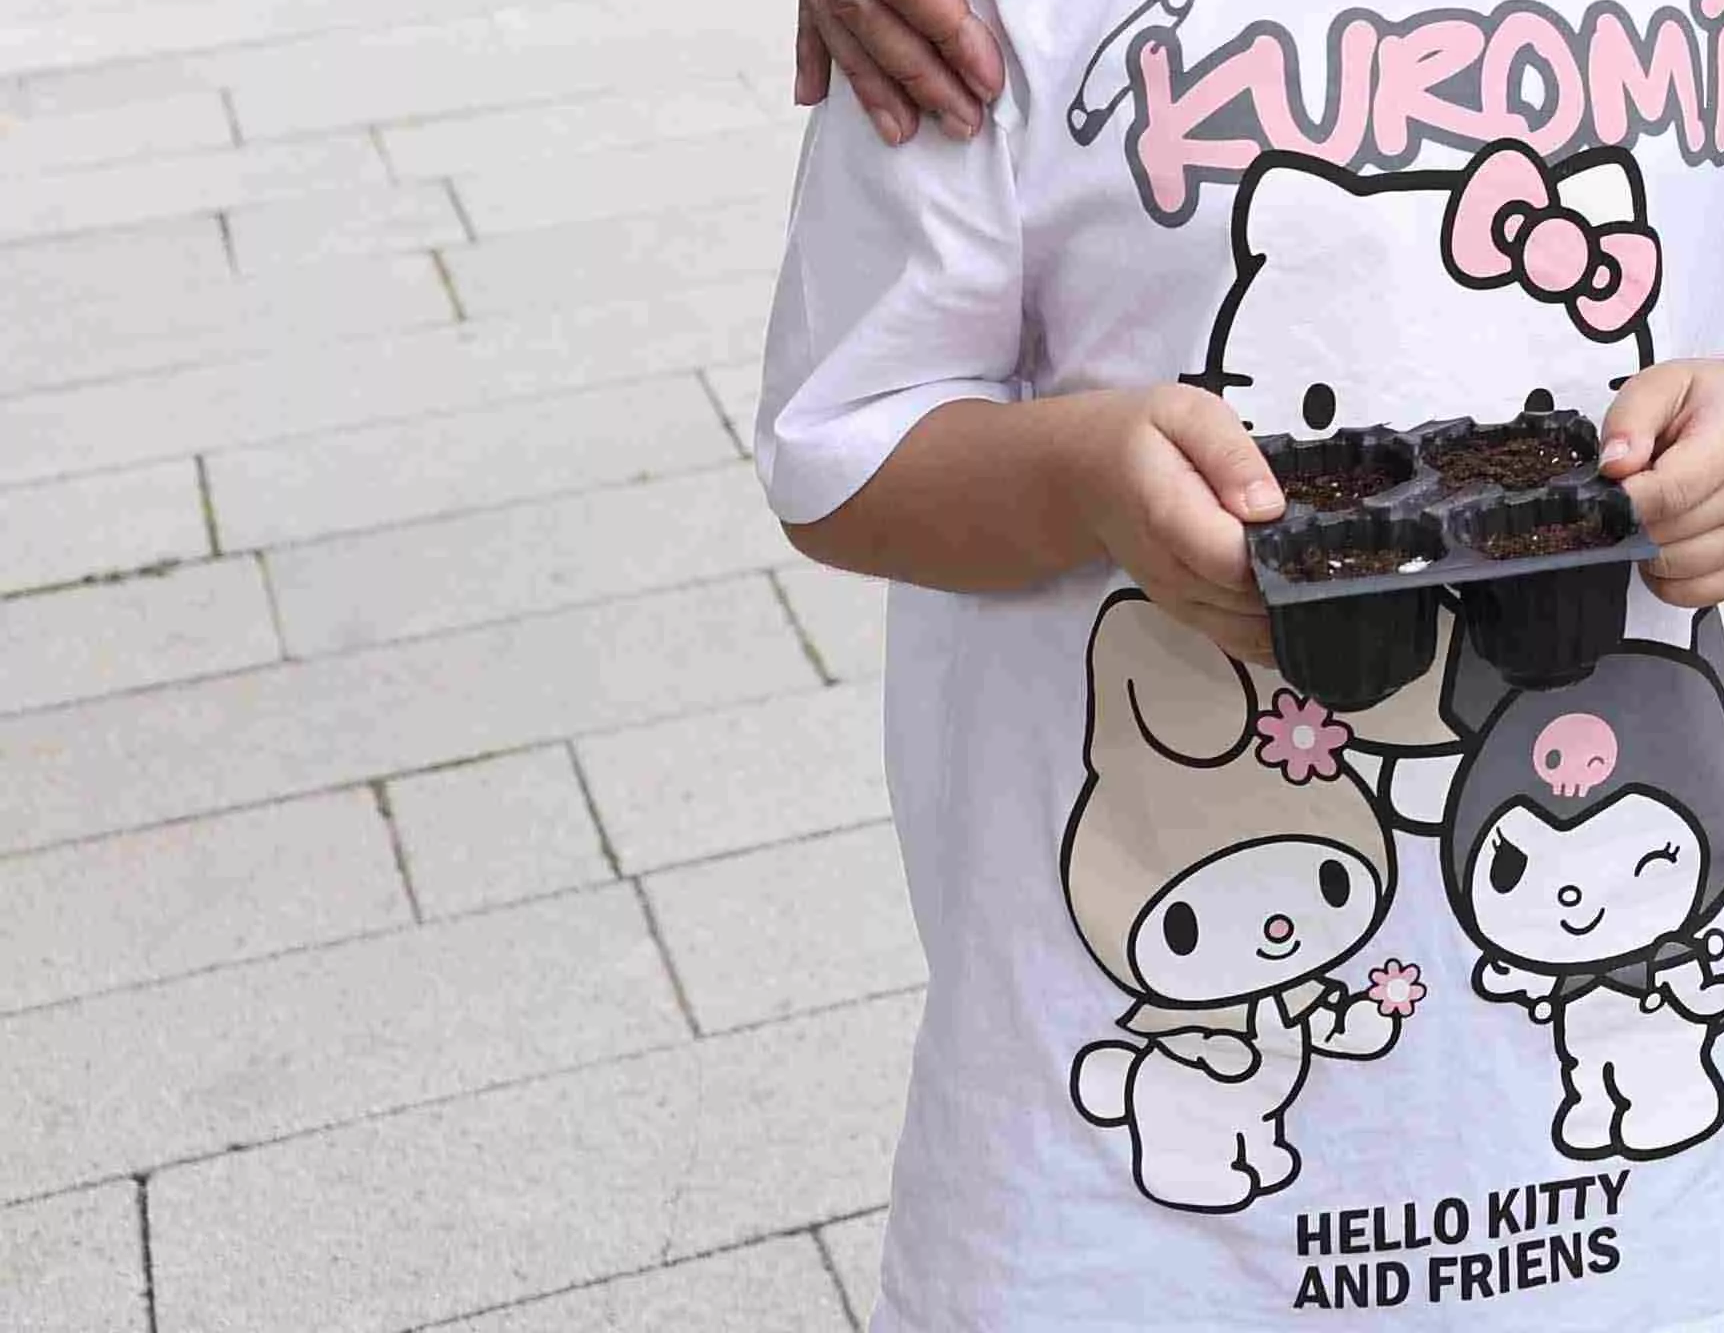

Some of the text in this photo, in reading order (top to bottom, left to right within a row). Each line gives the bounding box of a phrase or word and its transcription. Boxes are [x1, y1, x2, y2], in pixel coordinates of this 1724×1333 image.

[1296, 1169, 1631, 1257] HELLO KITTY
[1293, 1226, 1621, 1309] AND FRIENS
